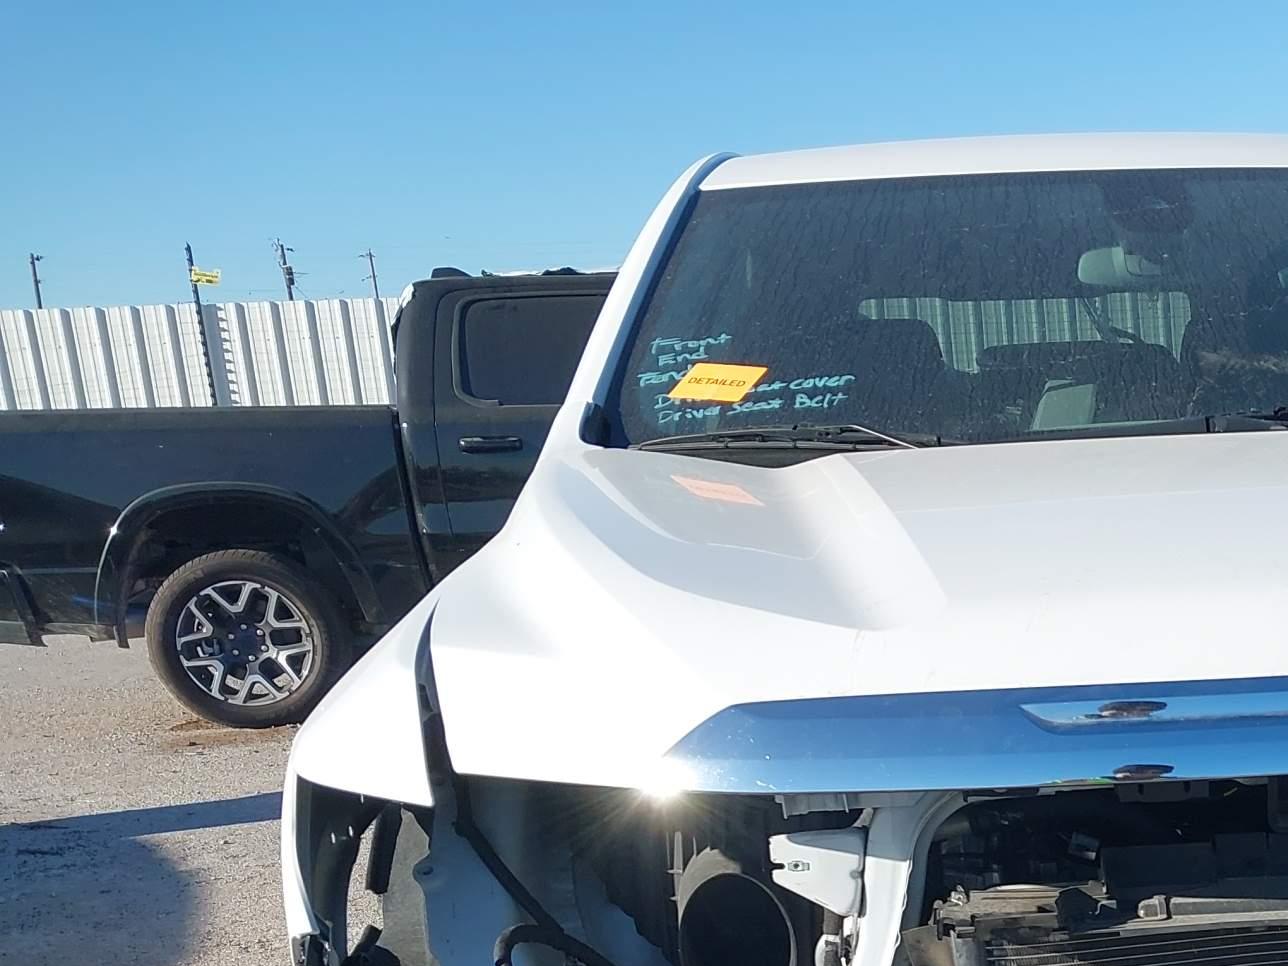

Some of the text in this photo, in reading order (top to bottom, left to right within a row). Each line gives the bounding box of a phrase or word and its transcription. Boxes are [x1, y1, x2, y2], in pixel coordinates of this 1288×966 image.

[650, 333, 733, 354] Front
[658, 347, 709, 366] End
[687, 377, 747, 388] DETAILED
[789, 375, 856, 390] cover
